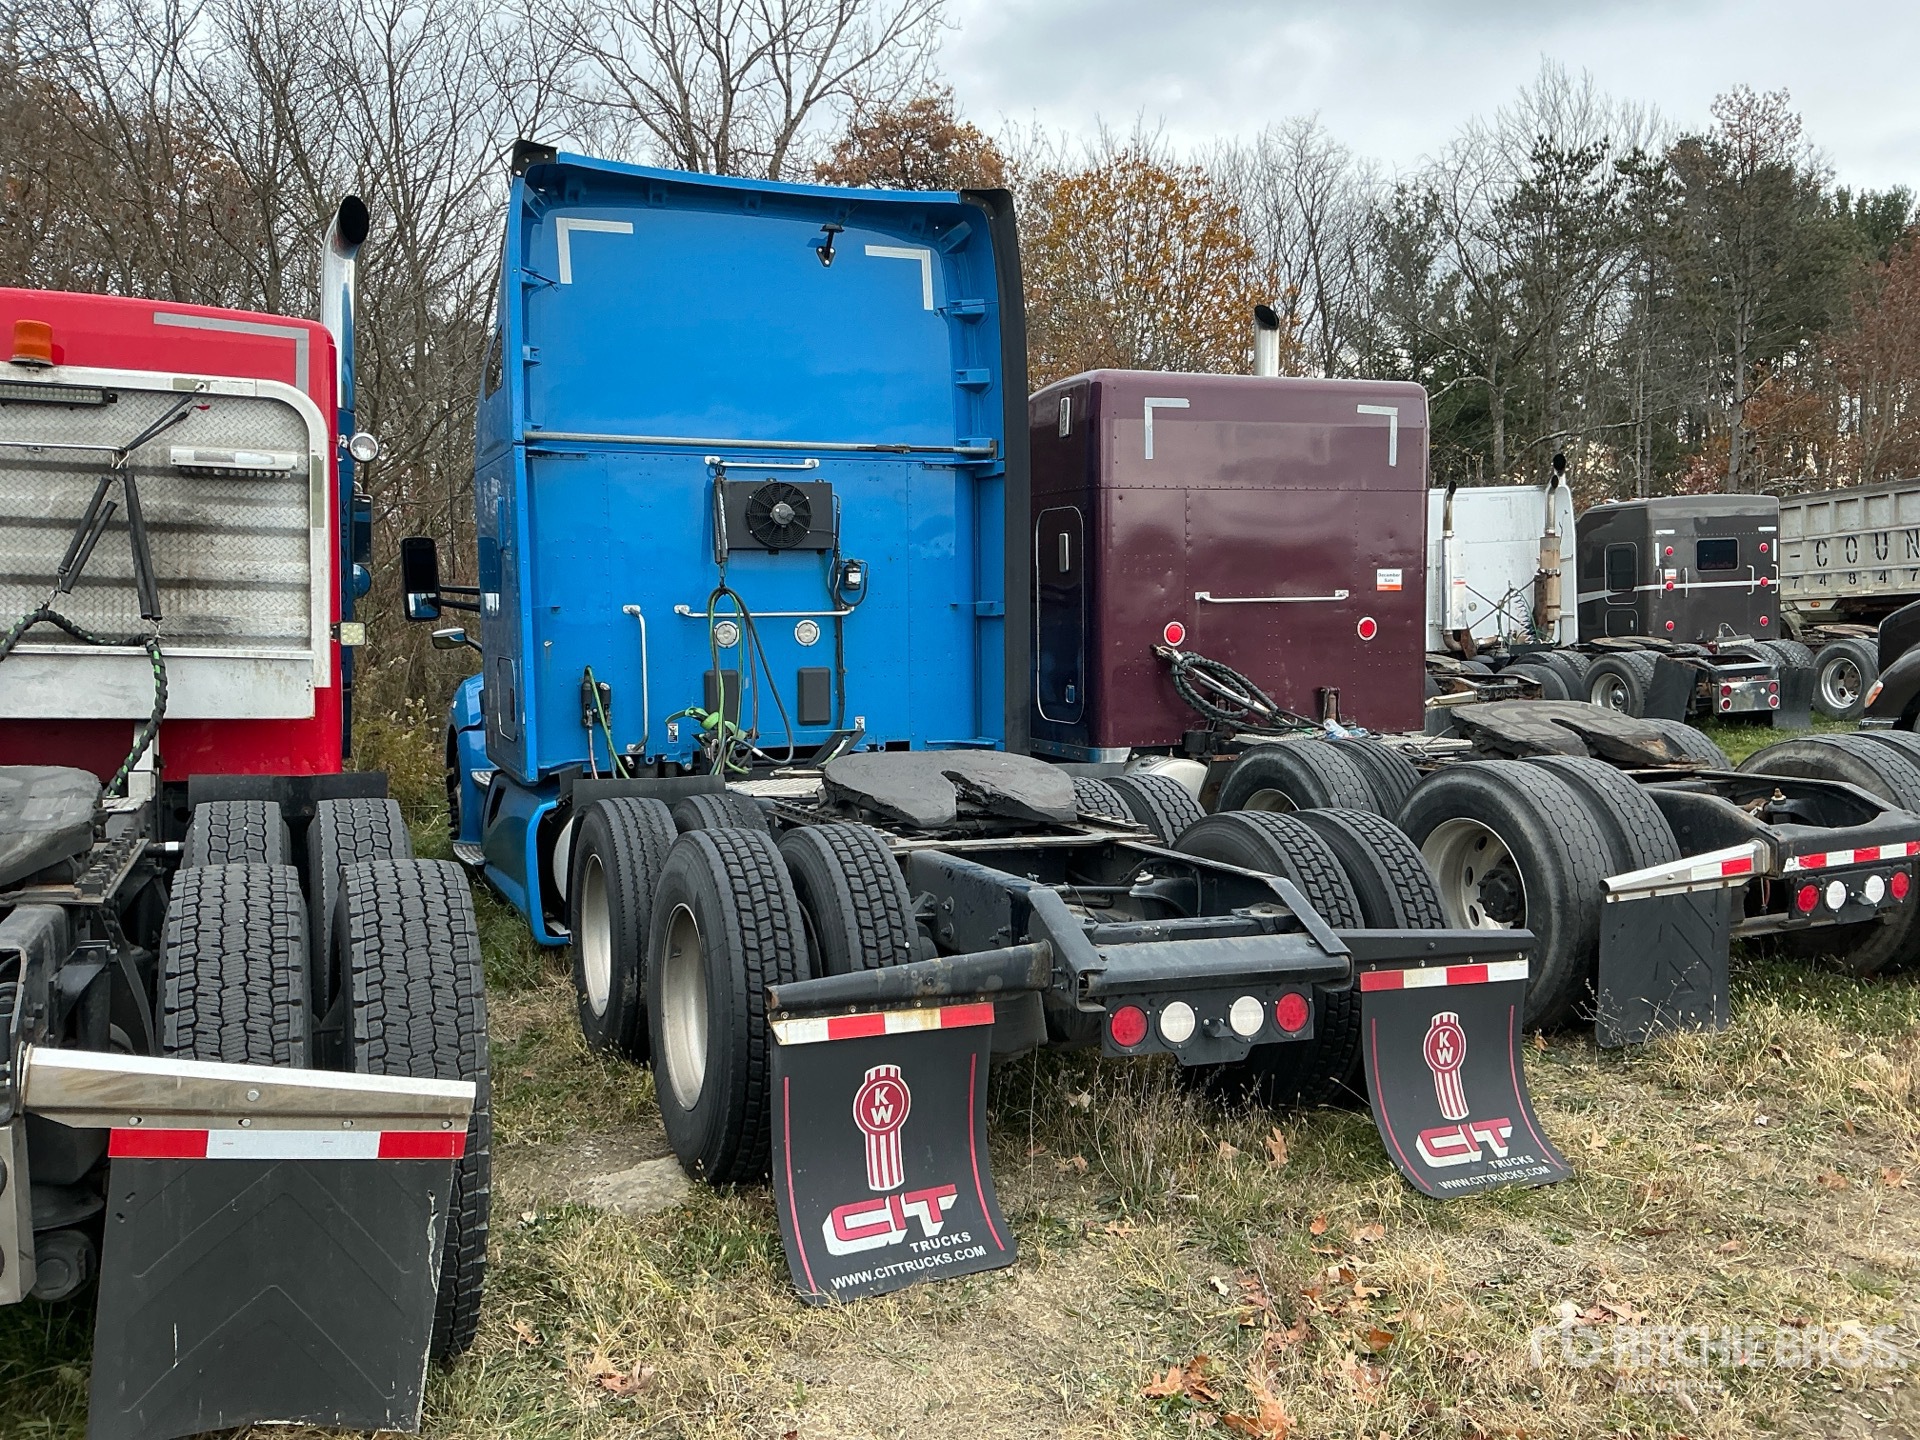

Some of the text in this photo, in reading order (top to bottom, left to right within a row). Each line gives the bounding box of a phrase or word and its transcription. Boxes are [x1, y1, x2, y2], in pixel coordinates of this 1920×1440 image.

[1416, 1118, 1512, 1167] CIT
[1438, 1165, 1551, 1189] WWW.CITTRUCKS.COM
[1488, 1155, 1534, 1168] TRUCKS
[822, 1184, 958, 1255] CIT
[910, 1231, 971, 1252] TRUCKS
[831, 1245, 986, 1289] WWW.CITTRUCKS.COM
